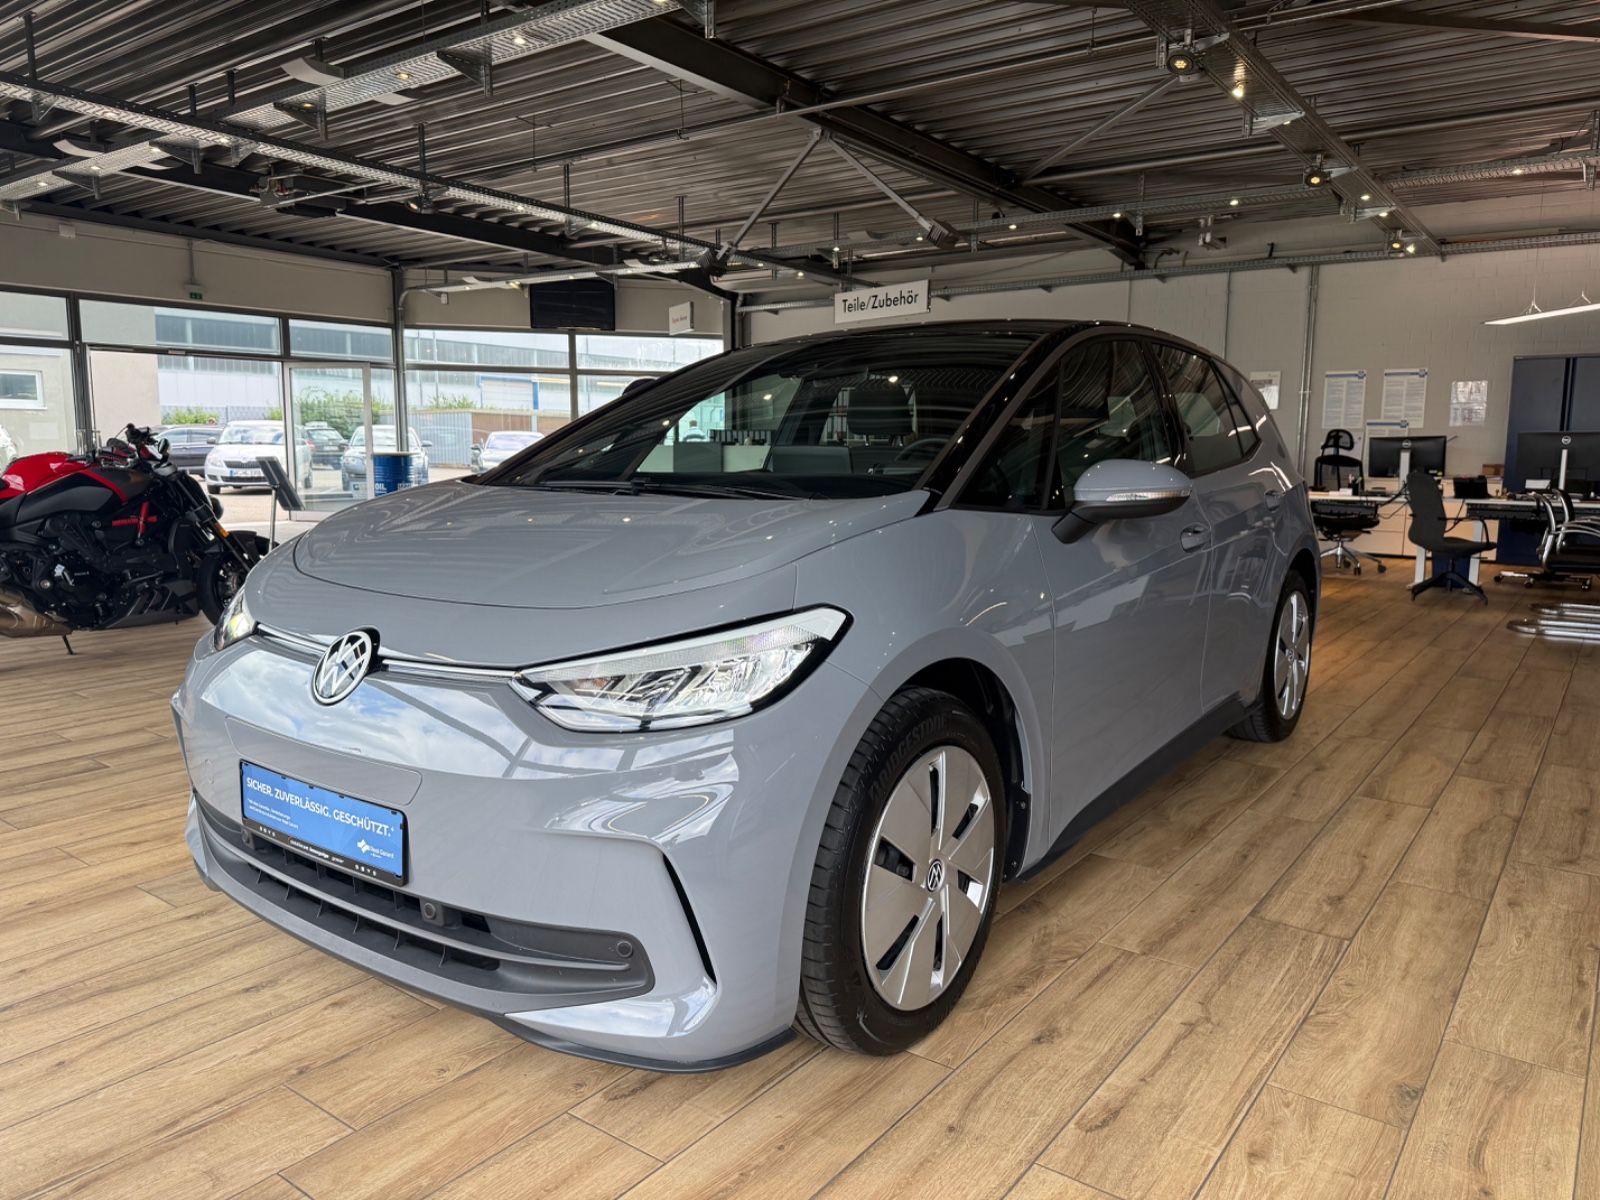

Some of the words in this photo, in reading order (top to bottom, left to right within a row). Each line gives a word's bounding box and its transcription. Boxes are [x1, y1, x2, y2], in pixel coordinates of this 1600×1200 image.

[842, 289, 919, 313] Teile/Zubehör
[246, 777, 274, 797] SICHER.
[274, 788, 332, 818] ZUVERLÄSSIG.
